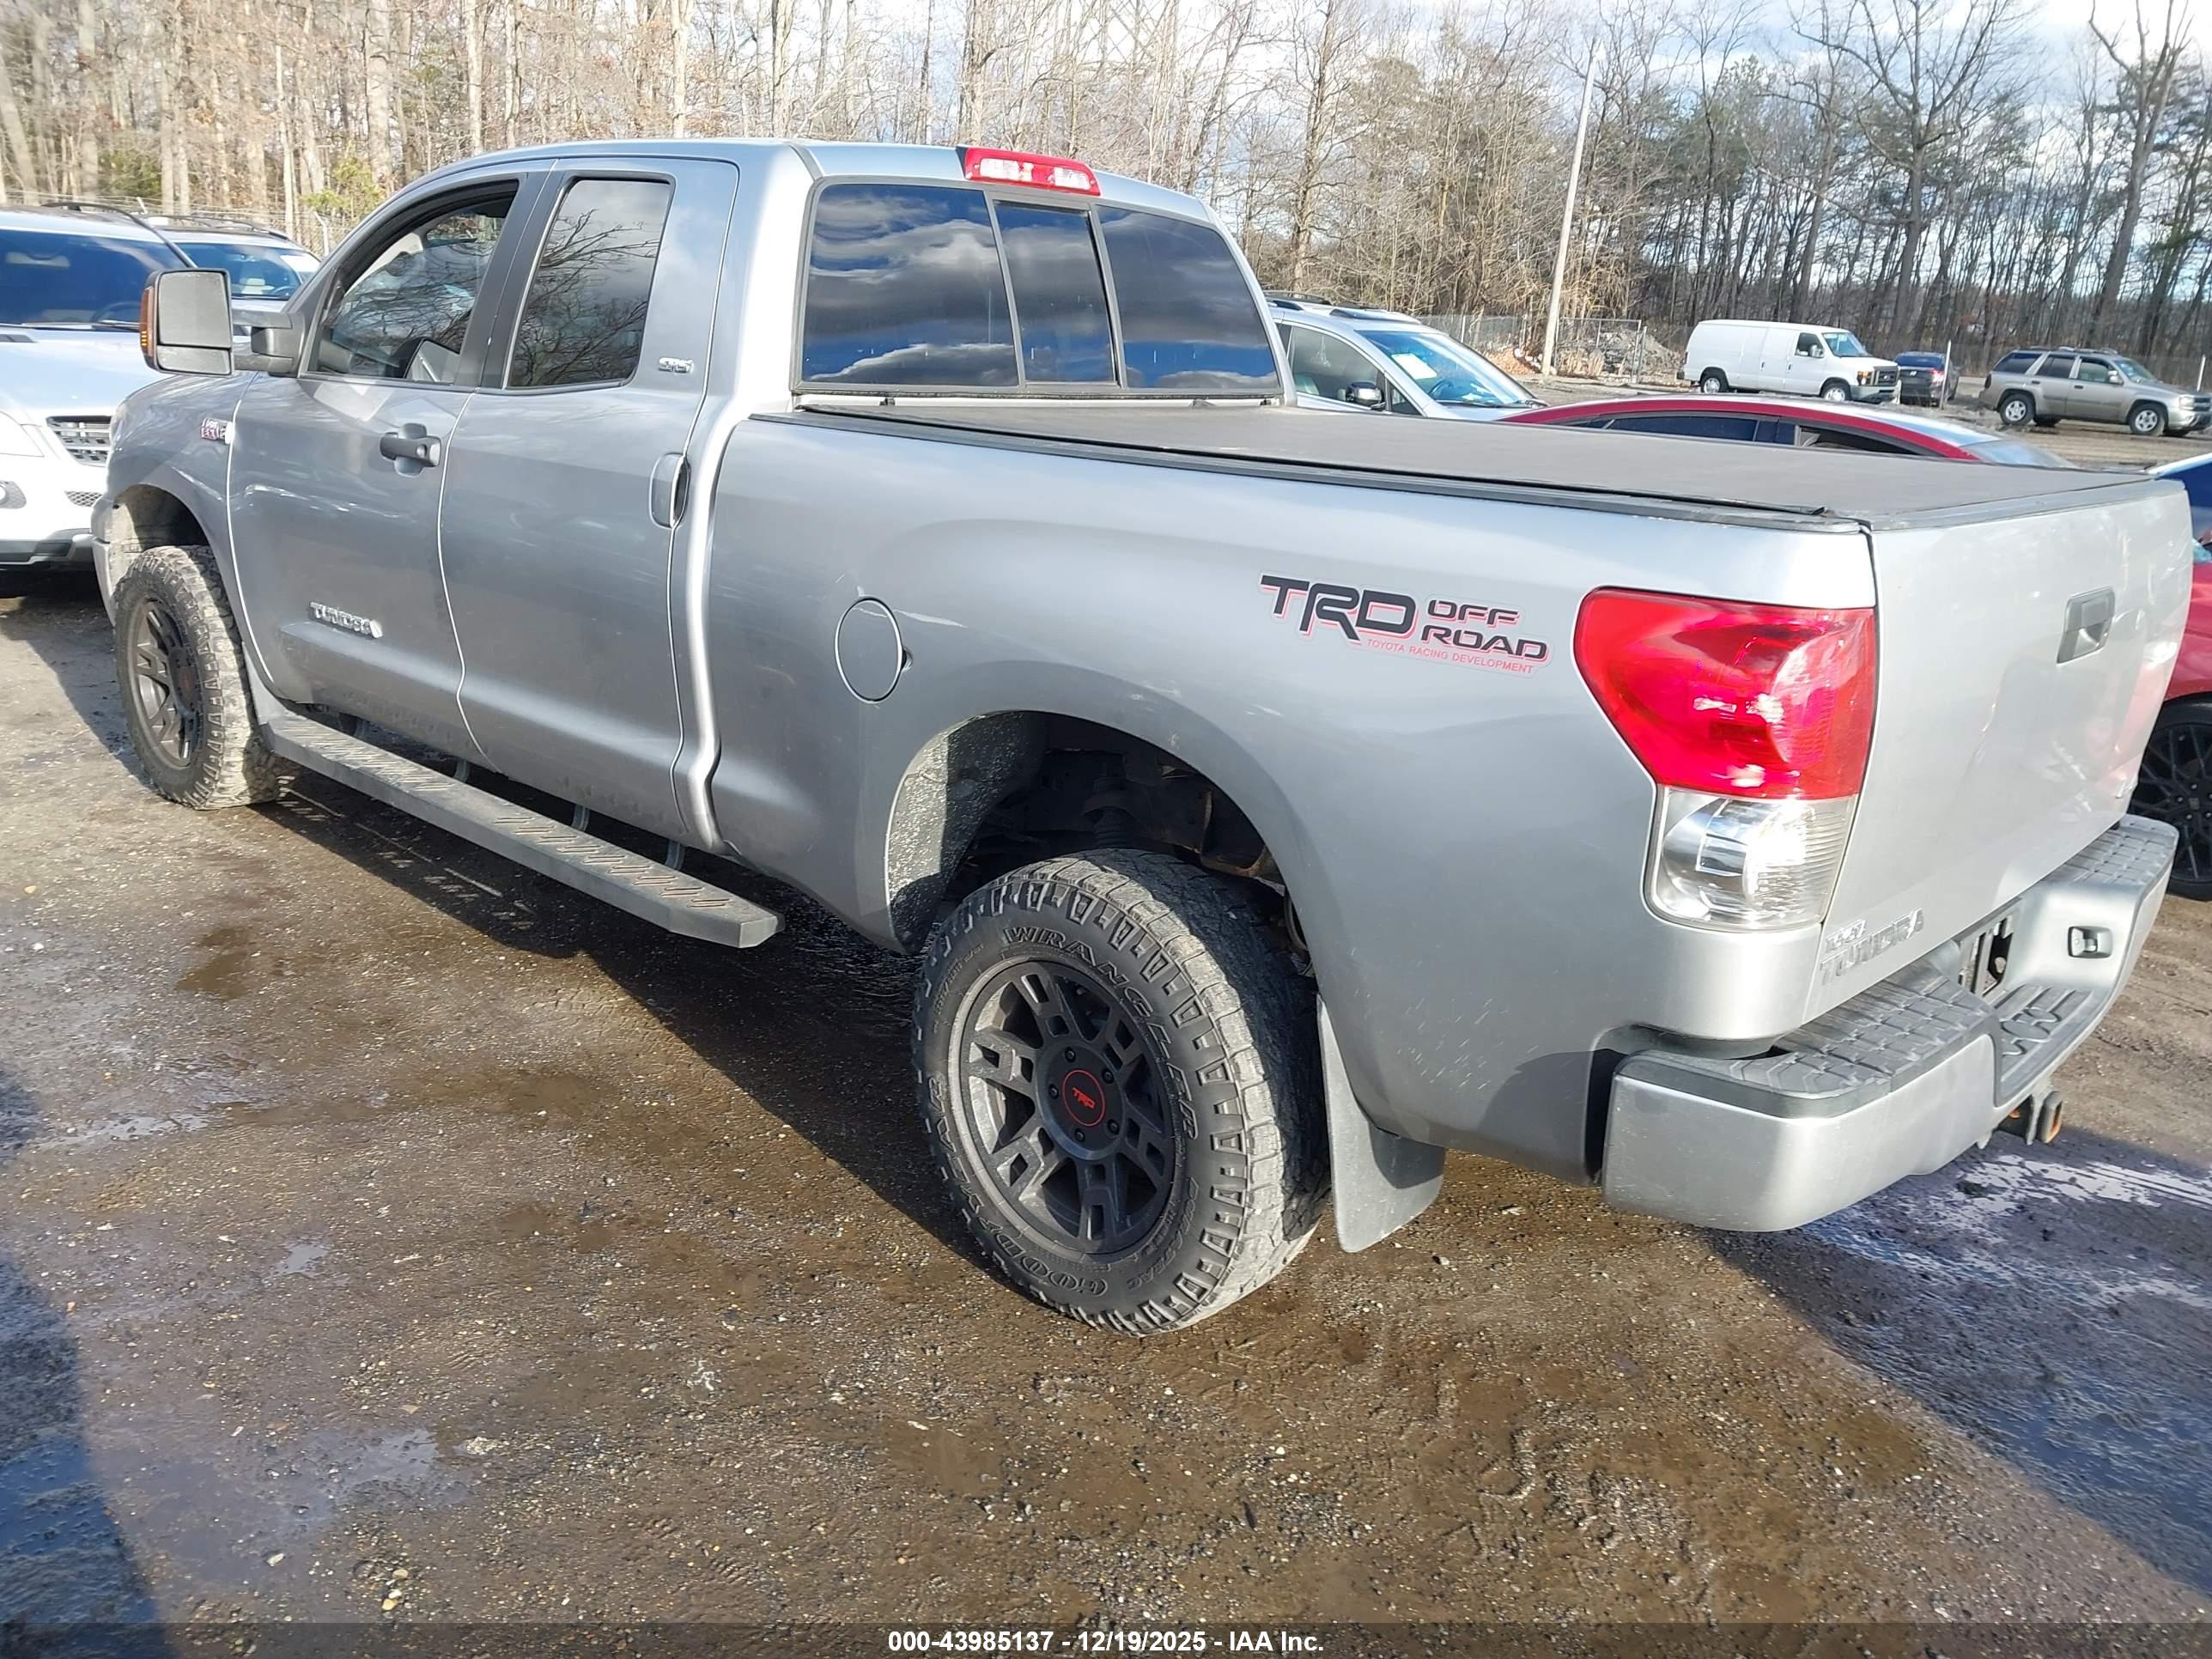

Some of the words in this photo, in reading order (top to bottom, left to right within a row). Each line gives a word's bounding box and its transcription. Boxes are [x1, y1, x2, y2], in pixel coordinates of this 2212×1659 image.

[1261, 574, 1418, 644] TRD
[1427, 599, 1520, 628] OFF
[1367, 638, 1406, 653] TOYOTA
[1409, 645, 1449, 660] RACING
[1451, 652, 1534, 674] DEVELOPMENT
[1421, 624, 1548, 662] ROAD
[1002, 925, 1200, 1141] WRANGLER
[1072, 1086, 1097, 1109] TRD
